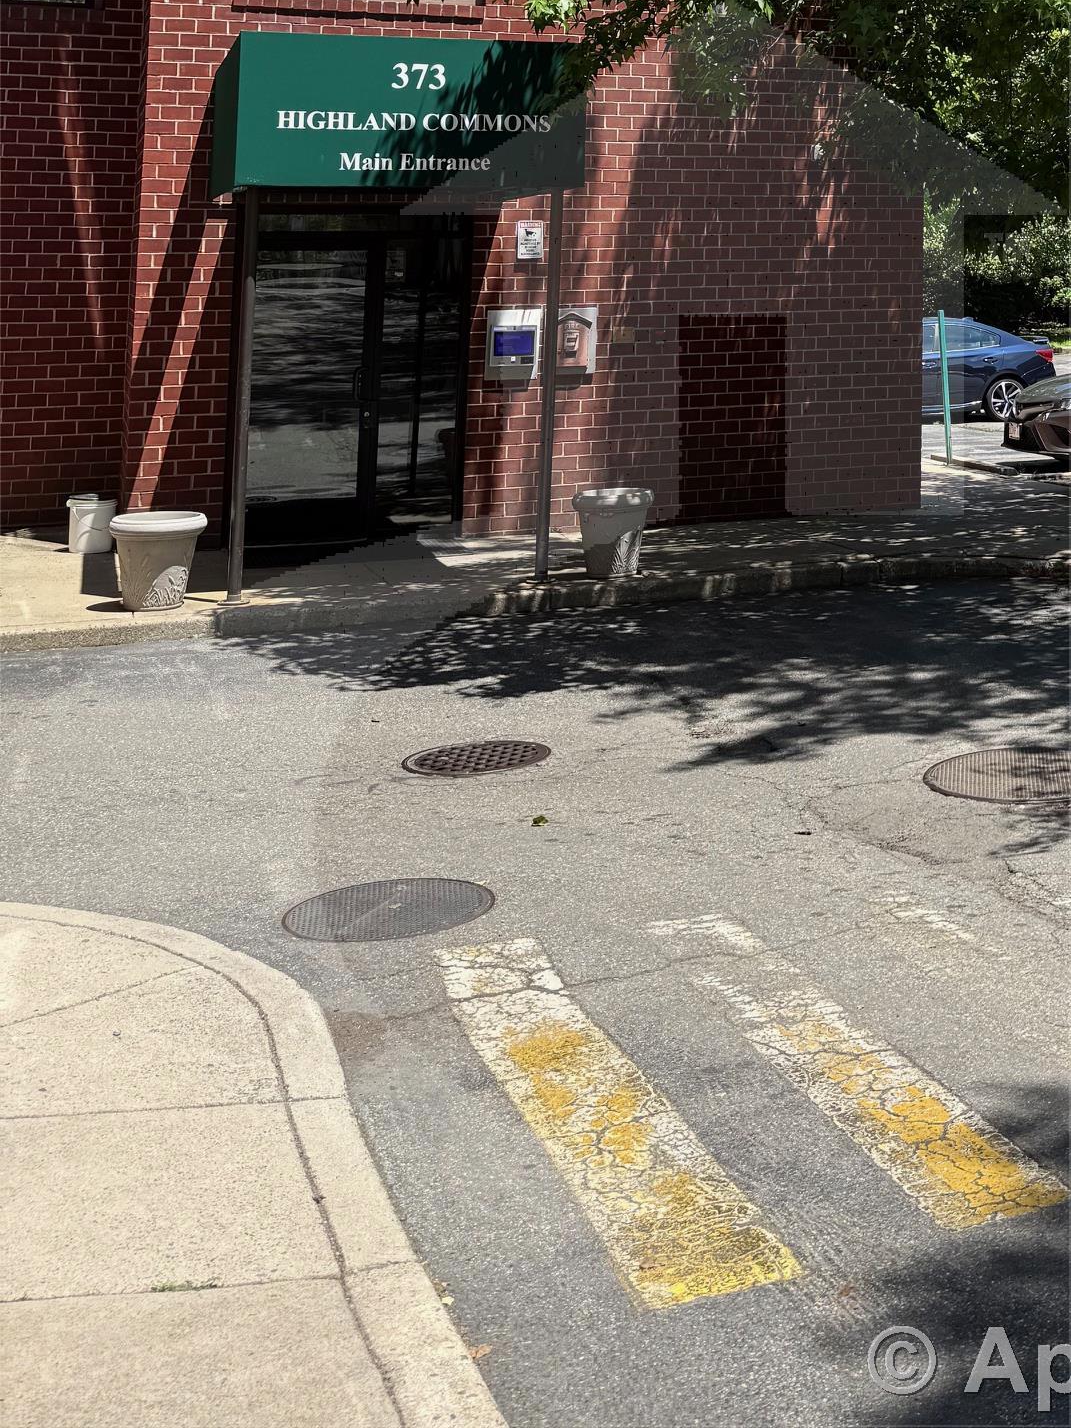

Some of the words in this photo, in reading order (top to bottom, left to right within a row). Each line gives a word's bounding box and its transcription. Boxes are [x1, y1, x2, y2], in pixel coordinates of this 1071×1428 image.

[391, 62, 447, 90] 373
[276, 110, 416, 132] HIGHLAND
[422, 113, 551, 133] COMMONS
[339, 152, 393, 171] Main
[399, 153, 491, 171] Entrance
